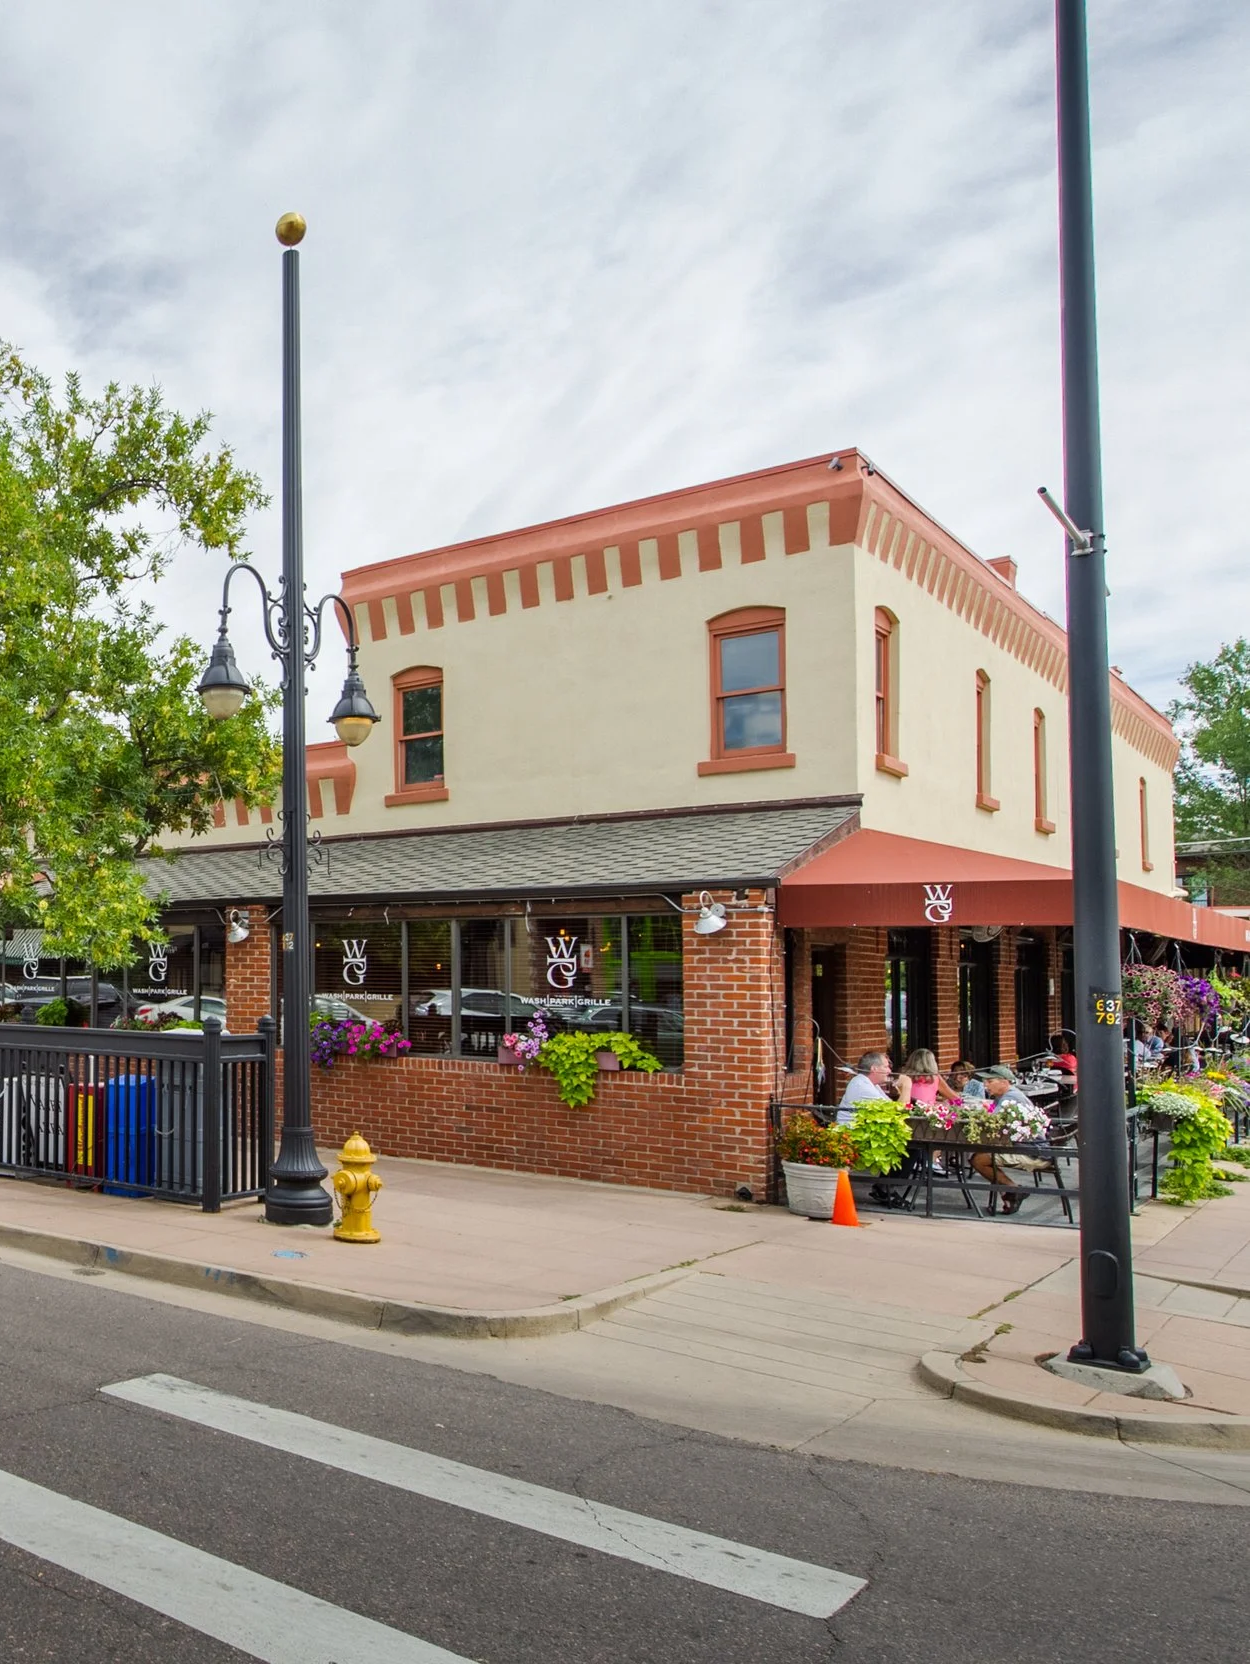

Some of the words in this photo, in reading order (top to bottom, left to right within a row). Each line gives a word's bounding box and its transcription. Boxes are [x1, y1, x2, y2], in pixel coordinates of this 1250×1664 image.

[550, 998, 575, 1006] PARK
[1096, 1000, 1121, 1012] 637
[1095, 1012, 1121, 1025] 792
